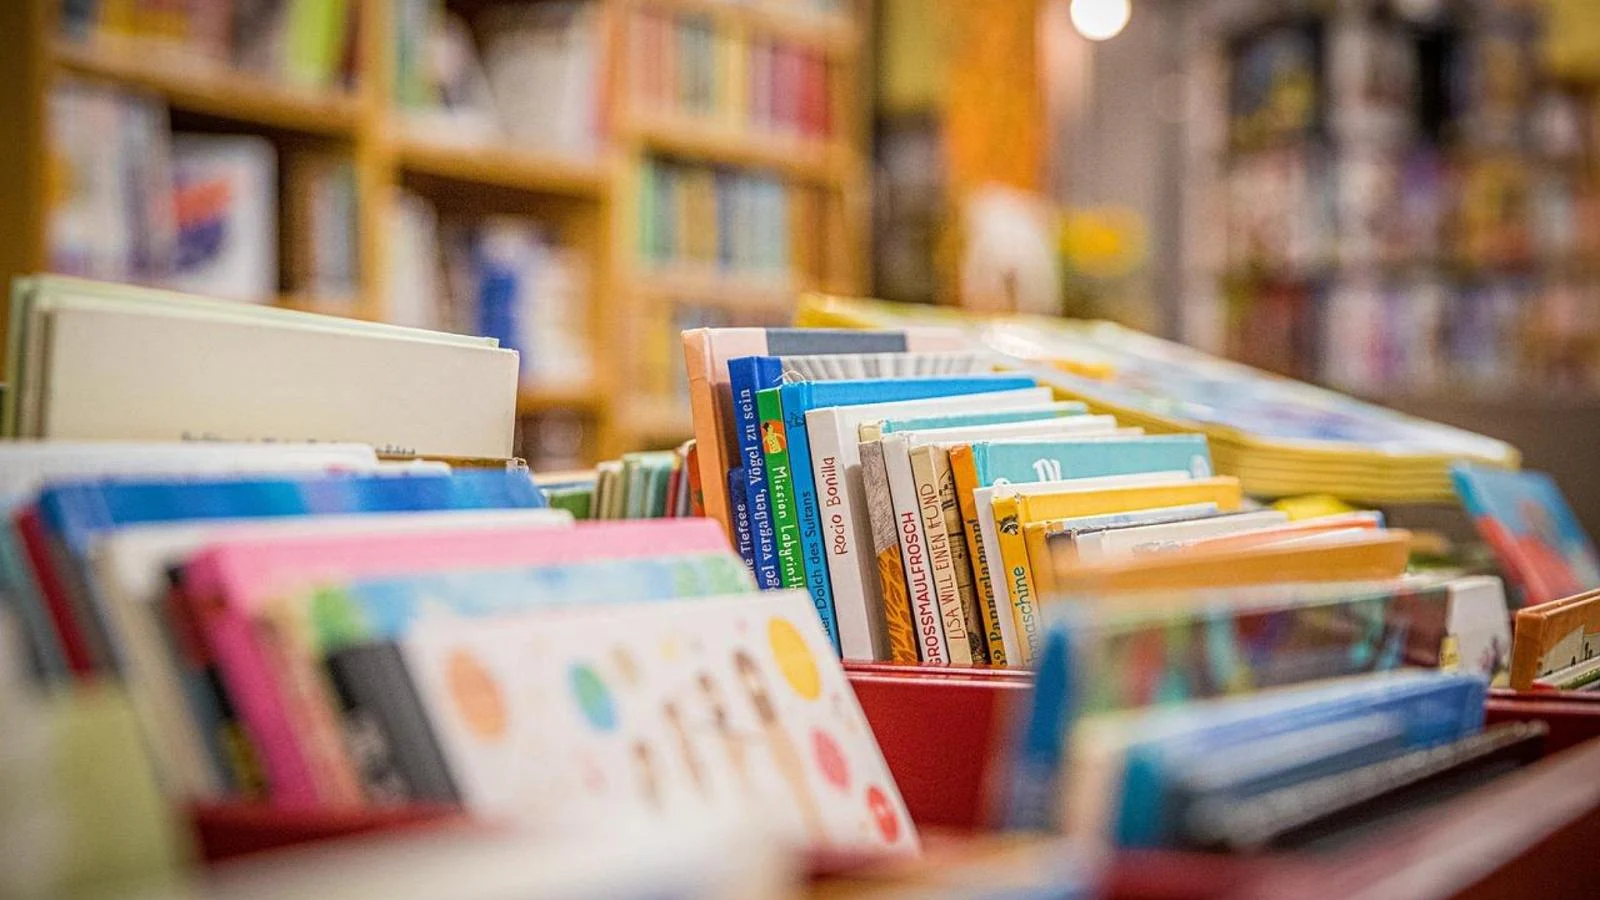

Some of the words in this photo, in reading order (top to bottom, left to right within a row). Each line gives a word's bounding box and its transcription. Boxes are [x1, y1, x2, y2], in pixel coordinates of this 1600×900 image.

[739, 389, 753, 419] sein
[746, 424, 756, 440] zu
[745, 445, 763, 485] Vögel
[821, 456, 841, 507] Bonilla
[772, 466, 787, 518] Mission
[737, 503, 751, 553] Tiefsee
[754, 489, 773, 560] vergaßen,
[803, 491, 816, 537] Sultans
[808, 542, 819, 564] des
[830, 514, 848, 555] Rocio
[930, 534, 950, 571] EINEN
[761, 564, 780, 590] gel
[778, 524, 803, 591] Labyrinth
[811, 570, 826, 610] Dolch
[939, 575, 955, 606] WILL
[945, 606, 966, 640] LISA
